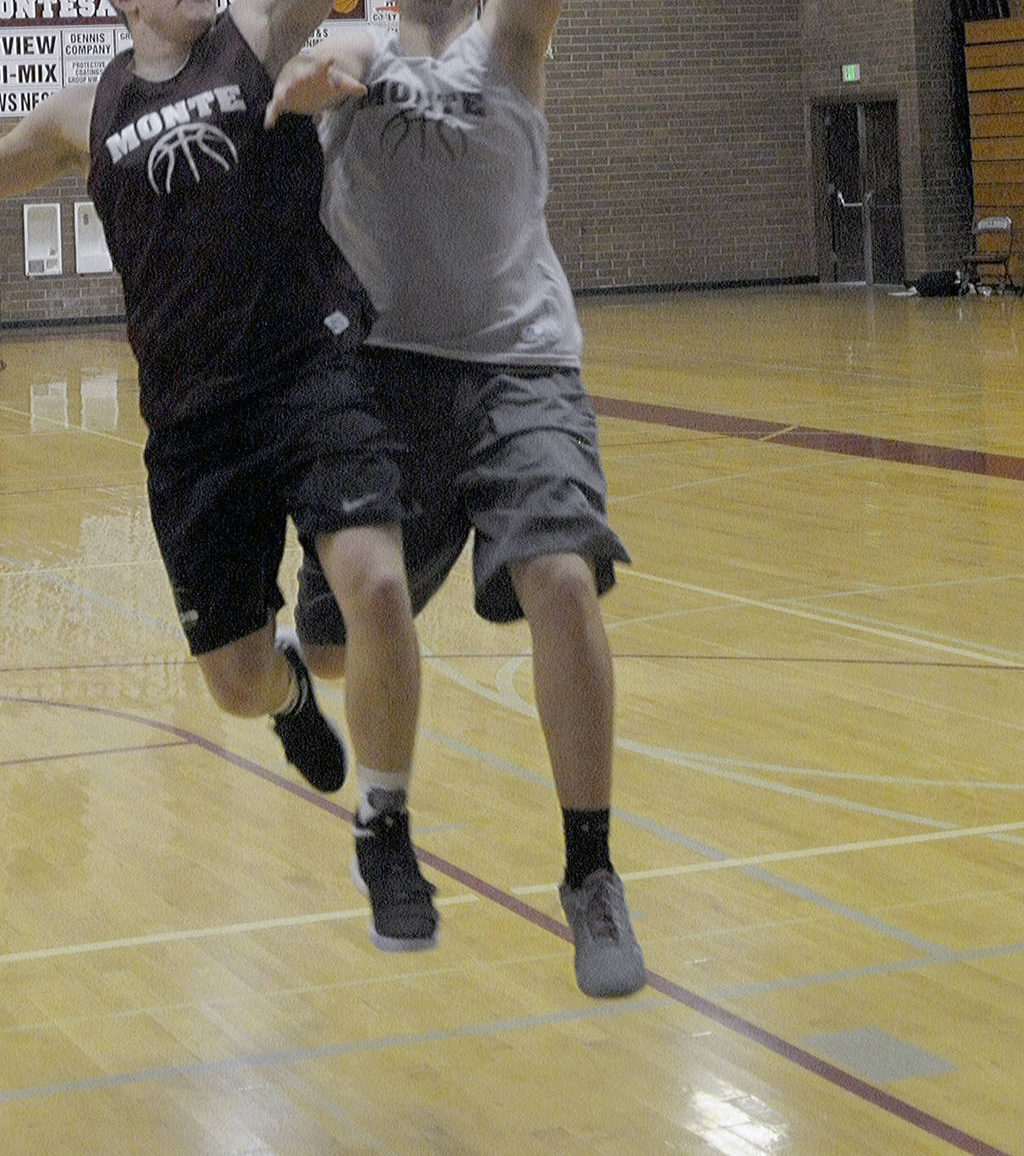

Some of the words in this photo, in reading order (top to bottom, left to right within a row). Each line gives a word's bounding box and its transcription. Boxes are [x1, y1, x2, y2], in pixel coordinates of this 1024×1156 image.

[70, 33, 105, 43] DENNIS
[65, 44, 111, 55] COMPANY
[105, 84, 247, 165] MONTE
